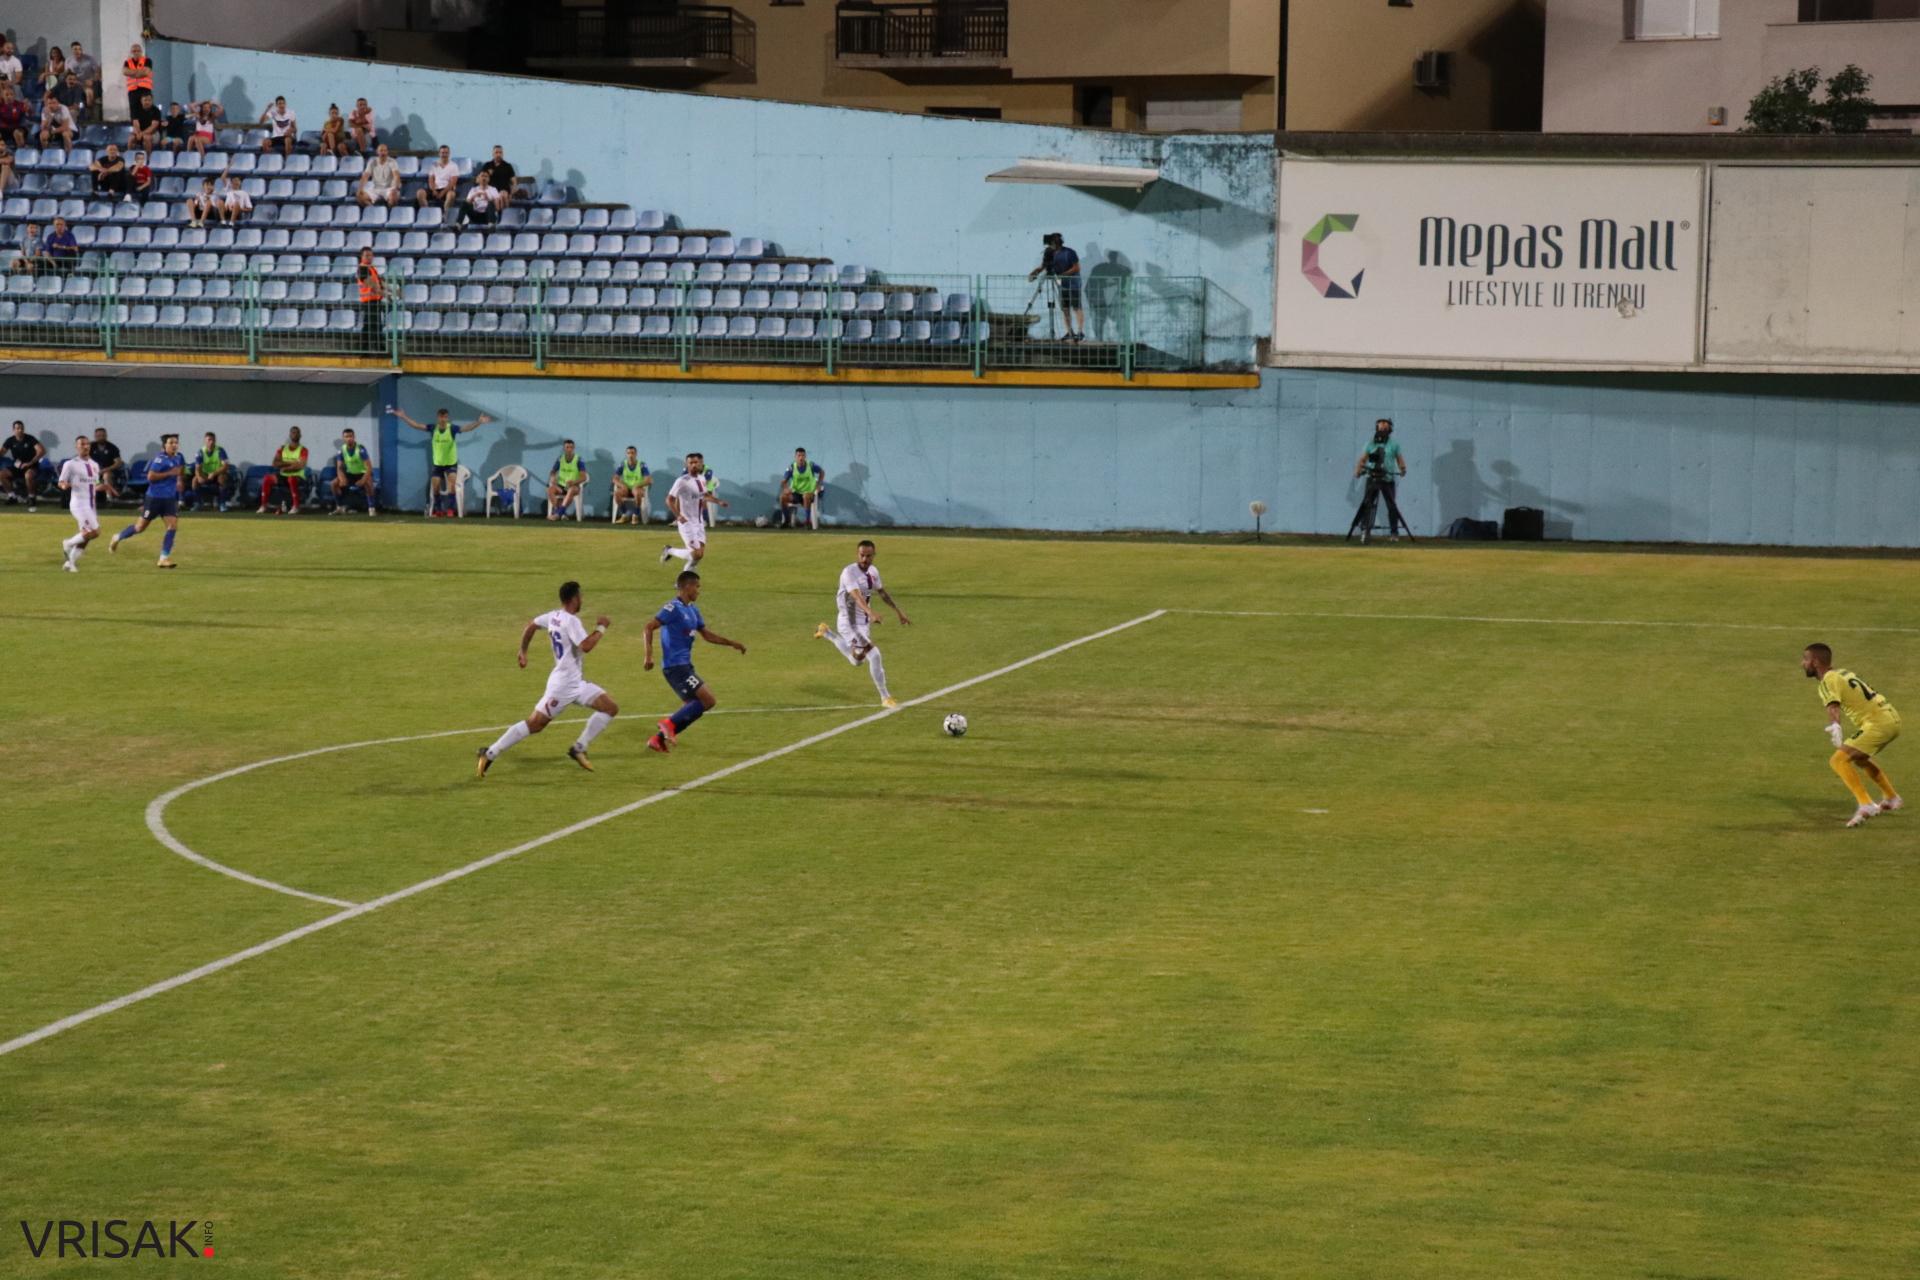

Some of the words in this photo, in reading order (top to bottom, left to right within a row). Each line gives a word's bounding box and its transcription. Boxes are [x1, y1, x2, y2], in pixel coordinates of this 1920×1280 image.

[1447, 279, 1545, 307] LIFESTYLE
[1553, 282, 1565, 308] U
[1572, 281, 1646, 310] TRENDU
